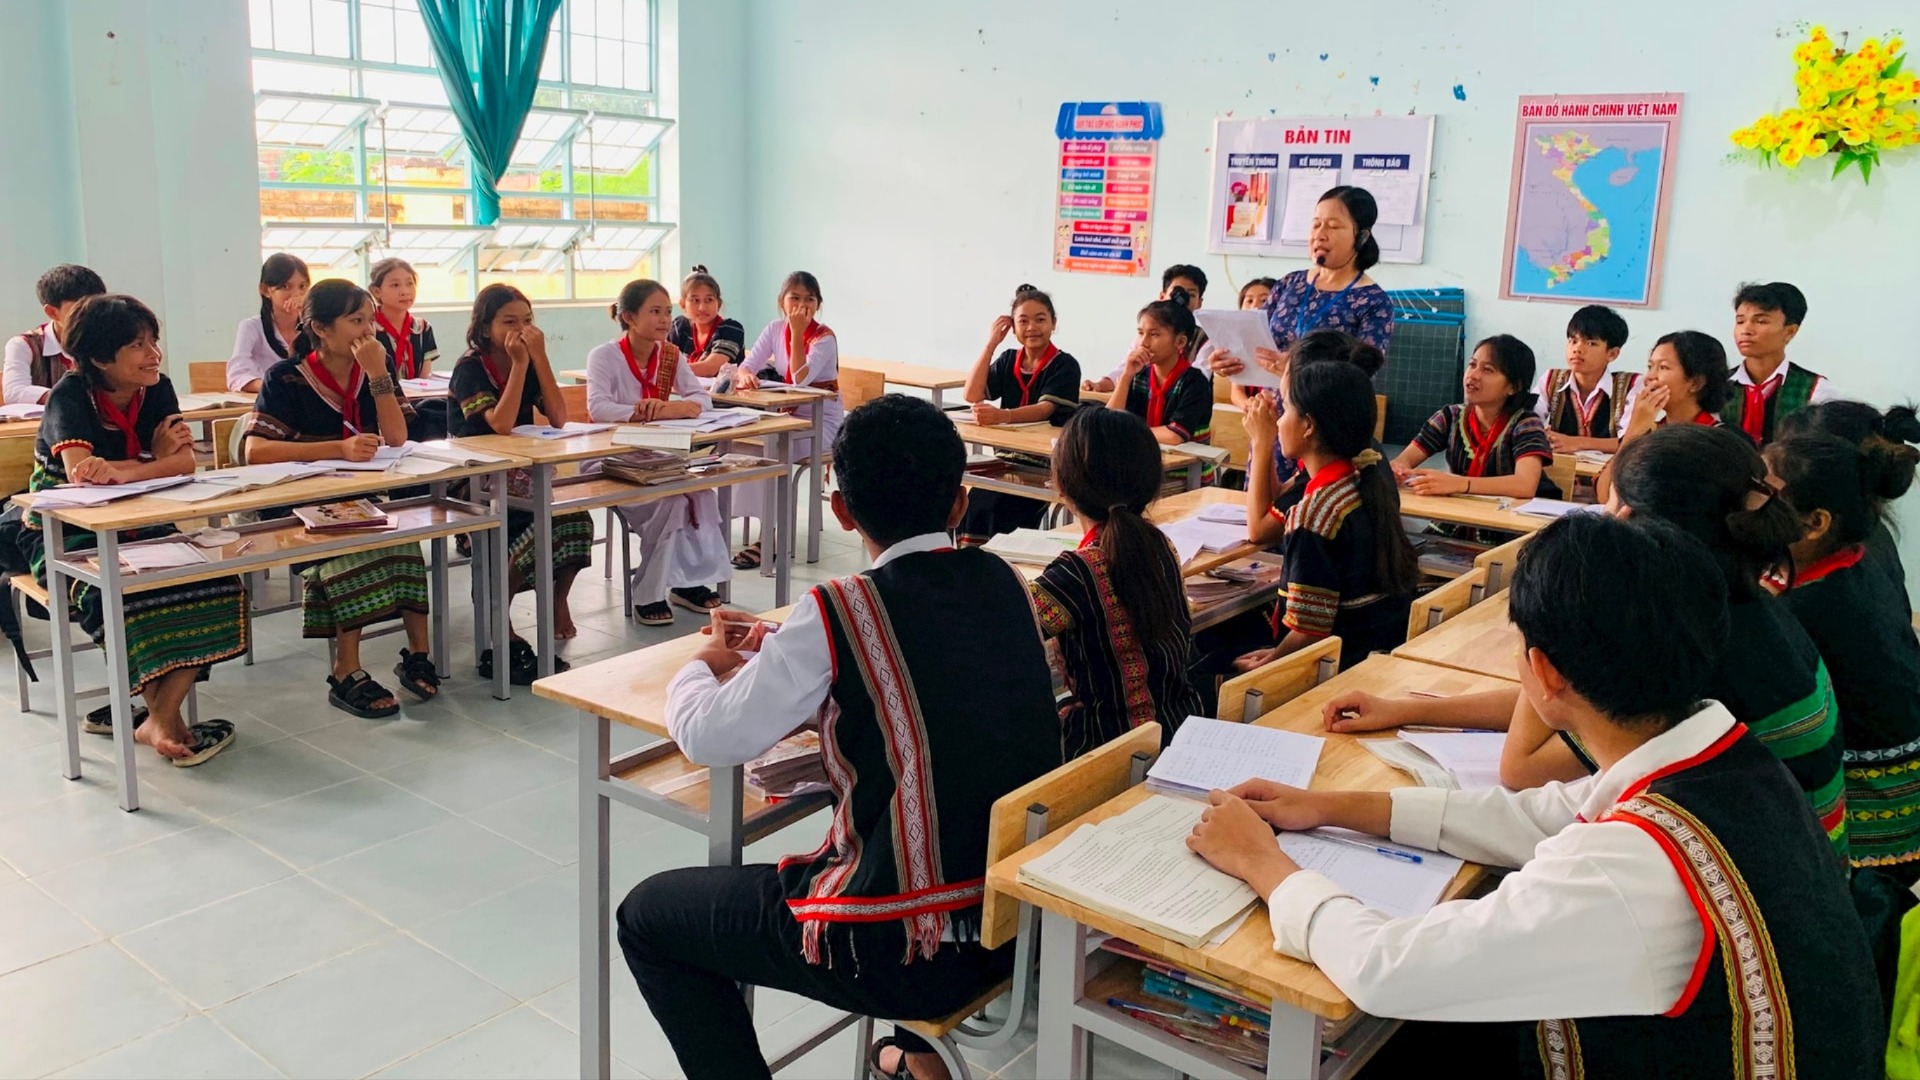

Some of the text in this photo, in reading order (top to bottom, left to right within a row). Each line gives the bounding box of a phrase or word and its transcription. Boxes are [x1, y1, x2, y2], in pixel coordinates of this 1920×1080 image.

[1522, 99, 1677, 118] BẢN ĐỒ HÀNH CHÍNH VIỆT NAM
[1285, 125, 1351, 145] BẢN TIN
[1255, 157, 1277, 167] THÔNG
[1299, 156, 1308, 167] KẾ
[1362, 157, 1401, 168] THÔNG BÁO
